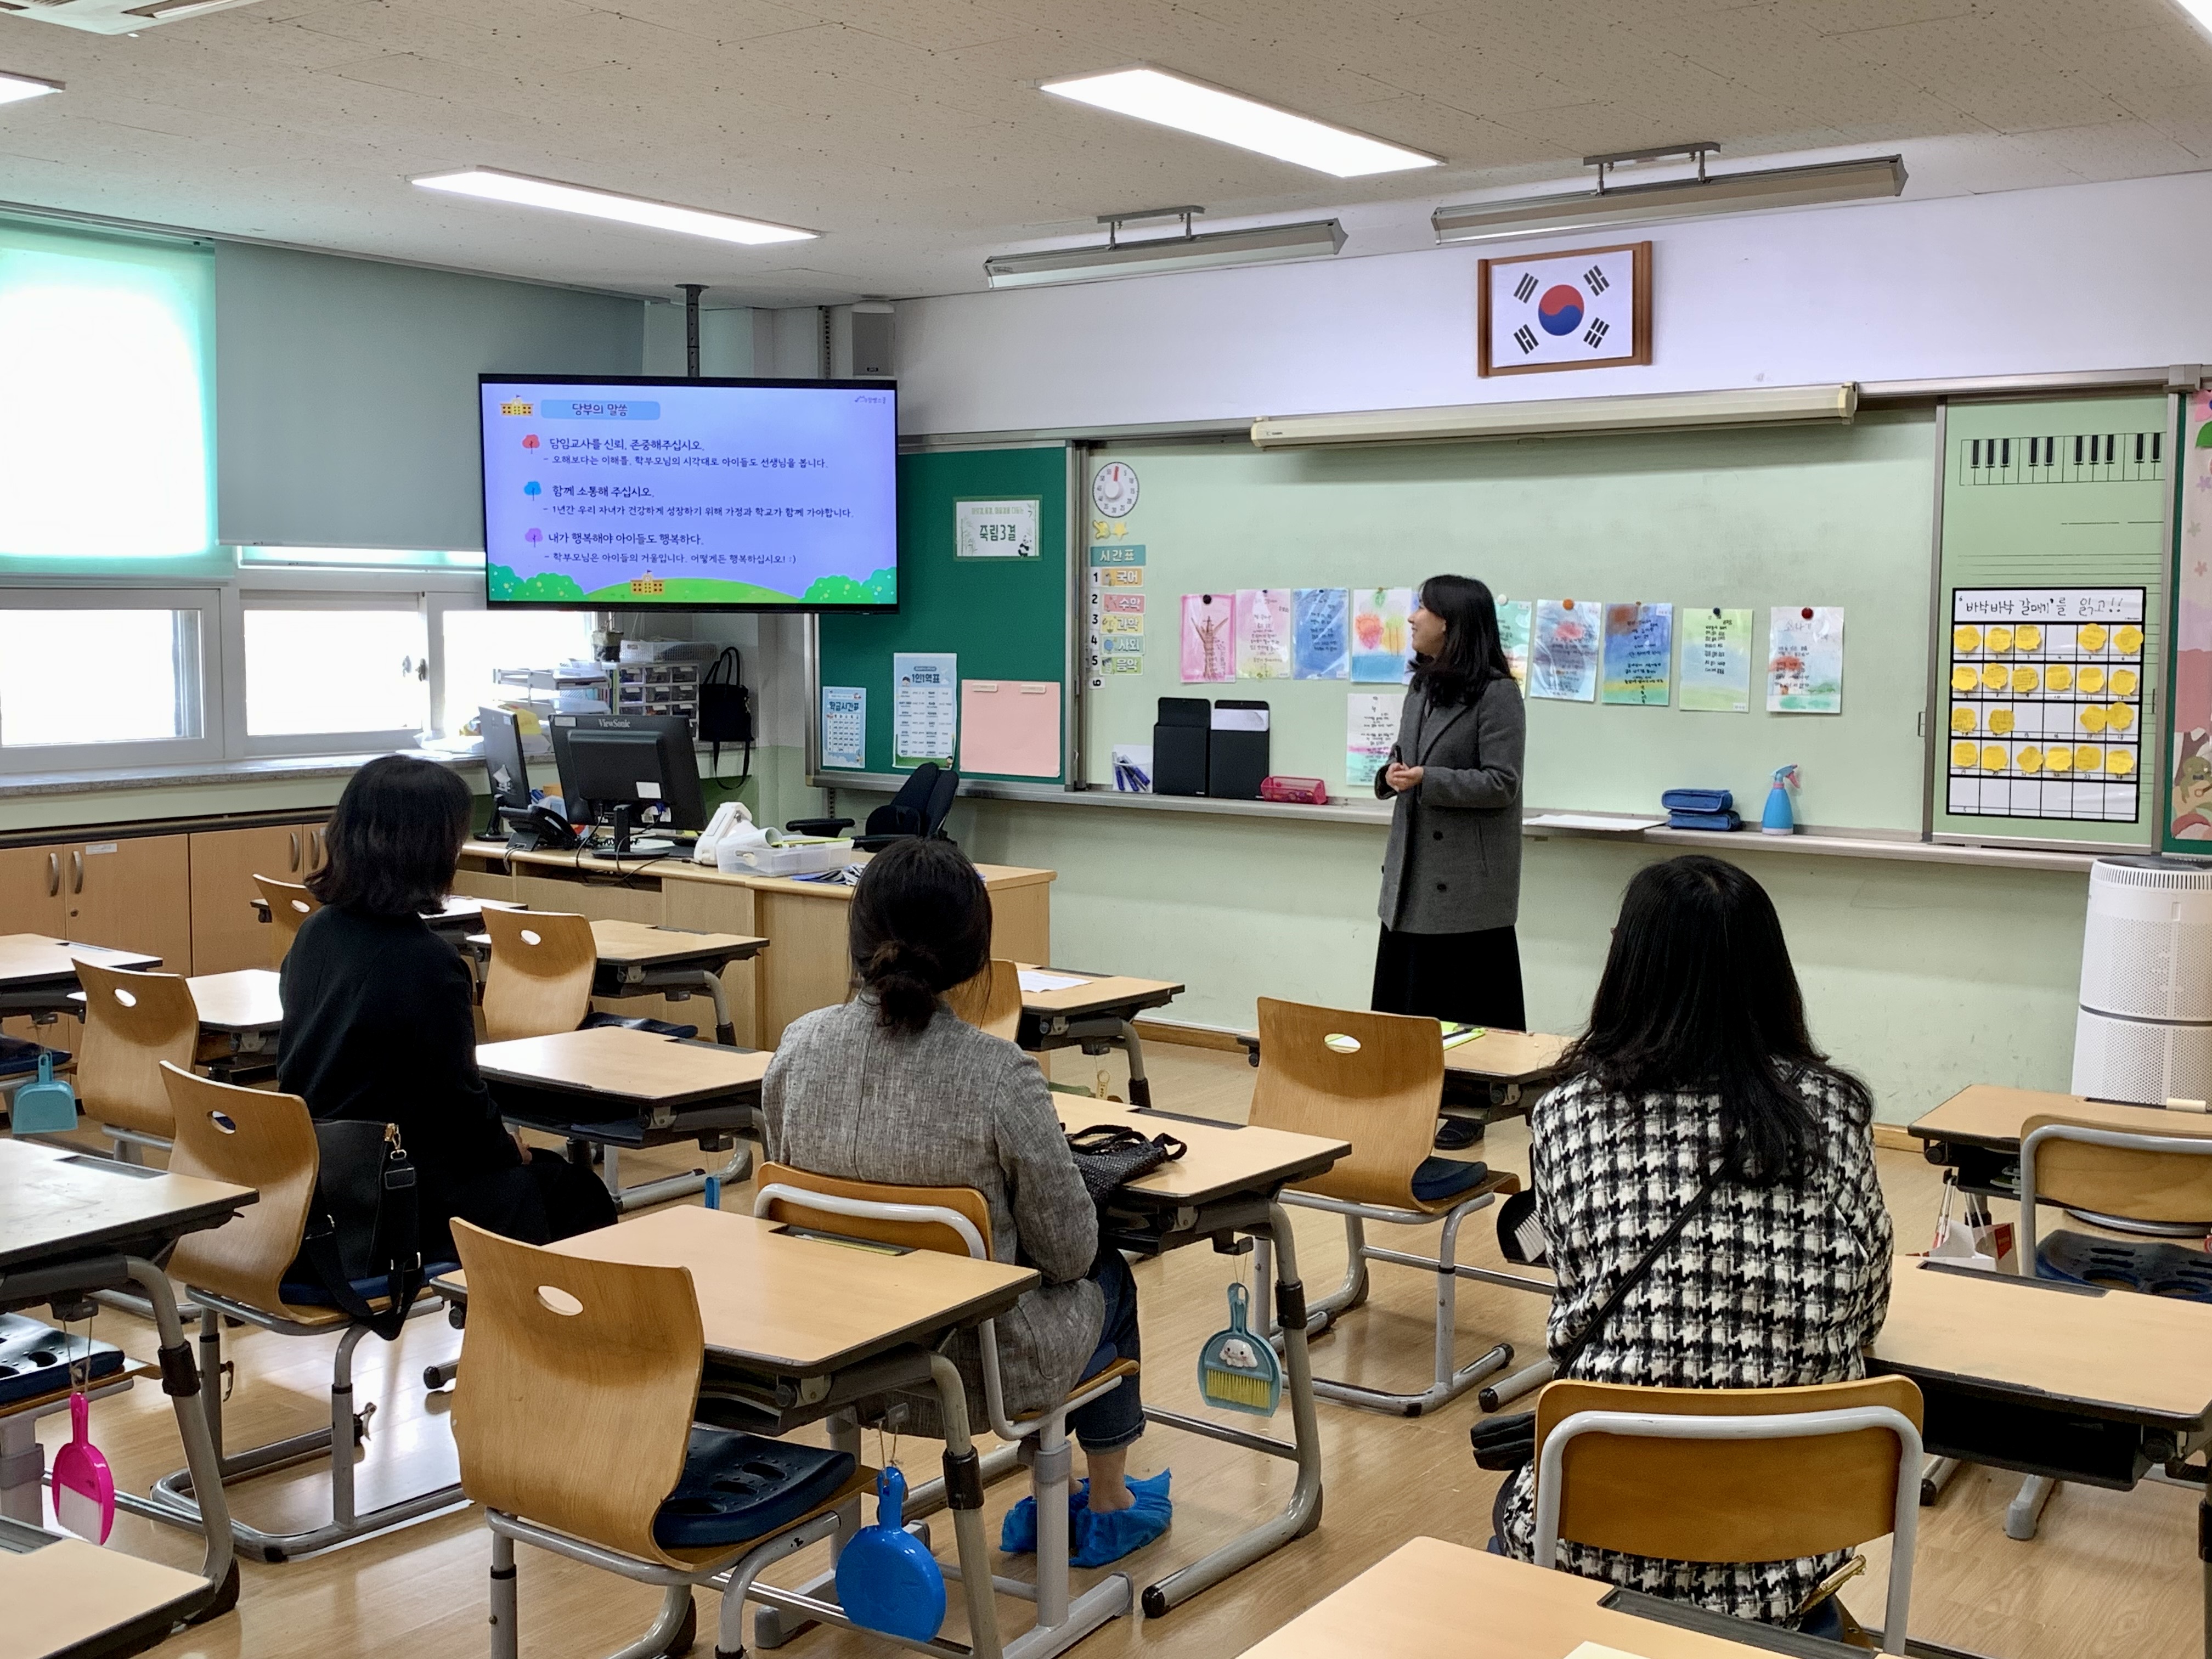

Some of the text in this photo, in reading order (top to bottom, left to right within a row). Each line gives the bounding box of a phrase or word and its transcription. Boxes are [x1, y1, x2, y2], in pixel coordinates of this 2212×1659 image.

[572, 403, 628, 416] 당부의 말씀
[550, 438, 602, 450] 담임교사를
[630, 439, 704, 452] 존중해주십시오.
[552, 455, 599, 465] 오해보다는
[635, 456, 680, 466] 학부모님의
[683, 456, 719, 466] 시각대로
[722, 457, 759, 467] 아이들도
[761, 458, 795, 468] 선생님을
[798, 458, 828, 468] 봅니다.
[552, 485, 654, 498] 함께 소통해 주십시오.
[552, 505, 854, 518] 1년간 우리 자녀가 건강하게 성장하기 위해 가정과 학교가 함께 가야합니다.
[549, 532, 704, 545] 내가 행복해야 아이들도 행복하다.
[980, 524, 1015, 541] 죽림3결
[553, 552, 599, 563] 학부모님은
[602, 553, 638, 563] 아이들의
[641, 553, 687, 564] 거울입니다.
[691, 554, 727, 564] 어떻게든
[730, 555, 786, 564] 행복하십시오!
[1099, 549, 1135, 562] 시간표
[1093, 570, 1138, 584] 1 국어
[1092, 594, 1141, 611] 2 수학
[2079, 597, 2123, 617] 읽고!!
[1092, 614, 1138, 631] 3 과학
[1091, 635, 1139, 651] 4 사회
[1092, 656, 1138, 672] 5 음악
[912, 673, 940, 684] 1인1역표
[829, 701, 859, 712] 학급시간표
[599, 719, 631, 728] ViewSonic
